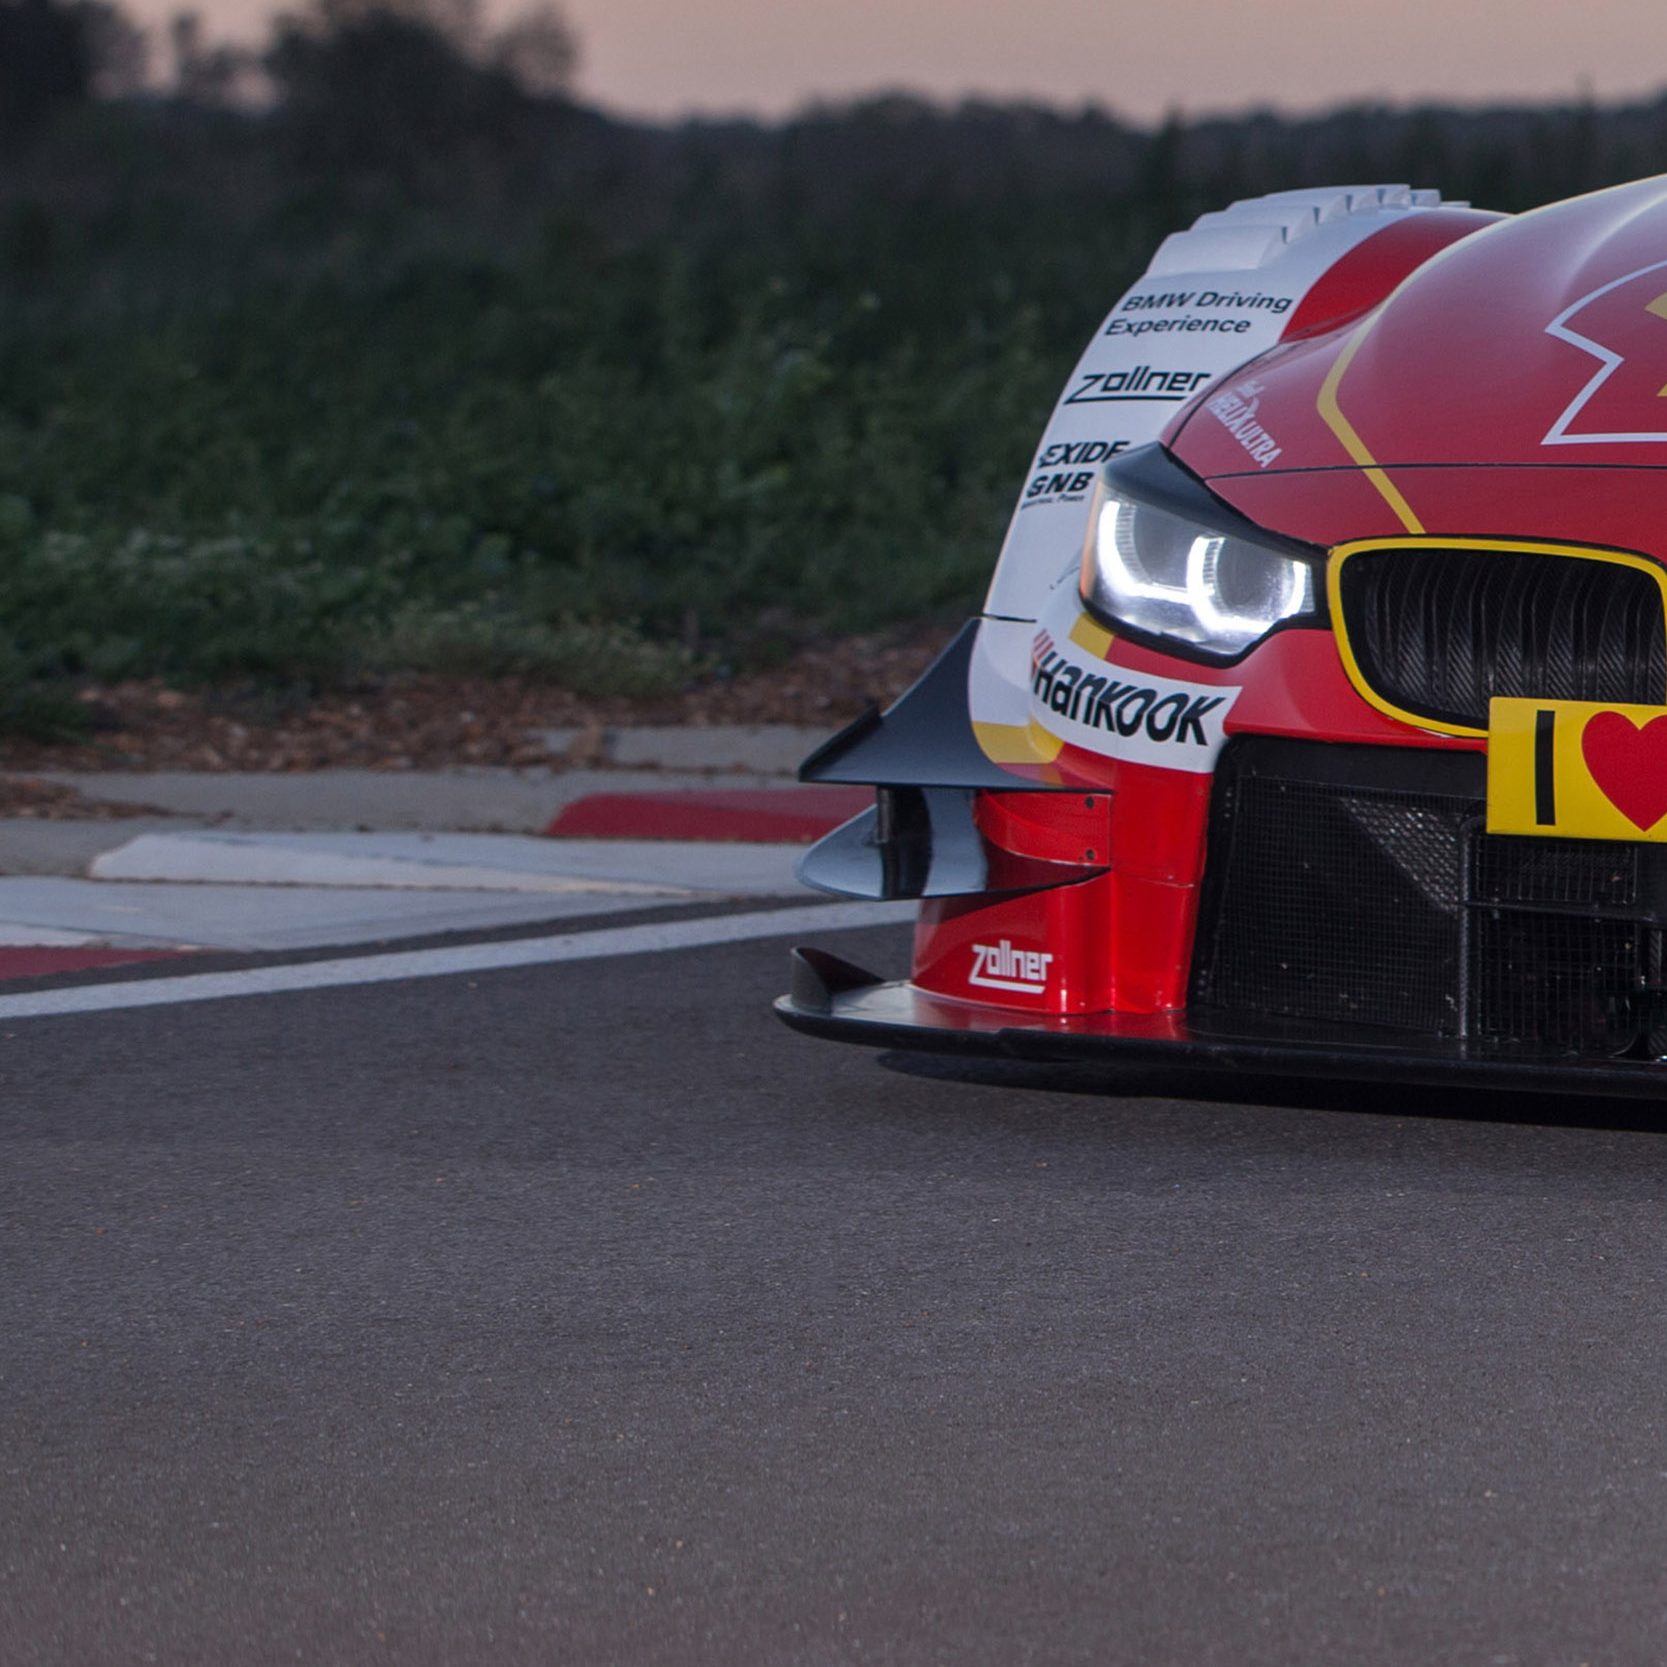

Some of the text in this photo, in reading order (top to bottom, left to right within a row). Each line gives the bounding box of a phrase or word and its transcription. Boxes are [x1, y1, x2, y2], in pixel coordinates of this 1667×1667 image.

[1121, 291, 1293, 314] BMW Driving
[1104, 314, 1251, 337] Experience
[1038, 440, 1130, 469] EXIDE
[1534, 709, 1556, 826] I
